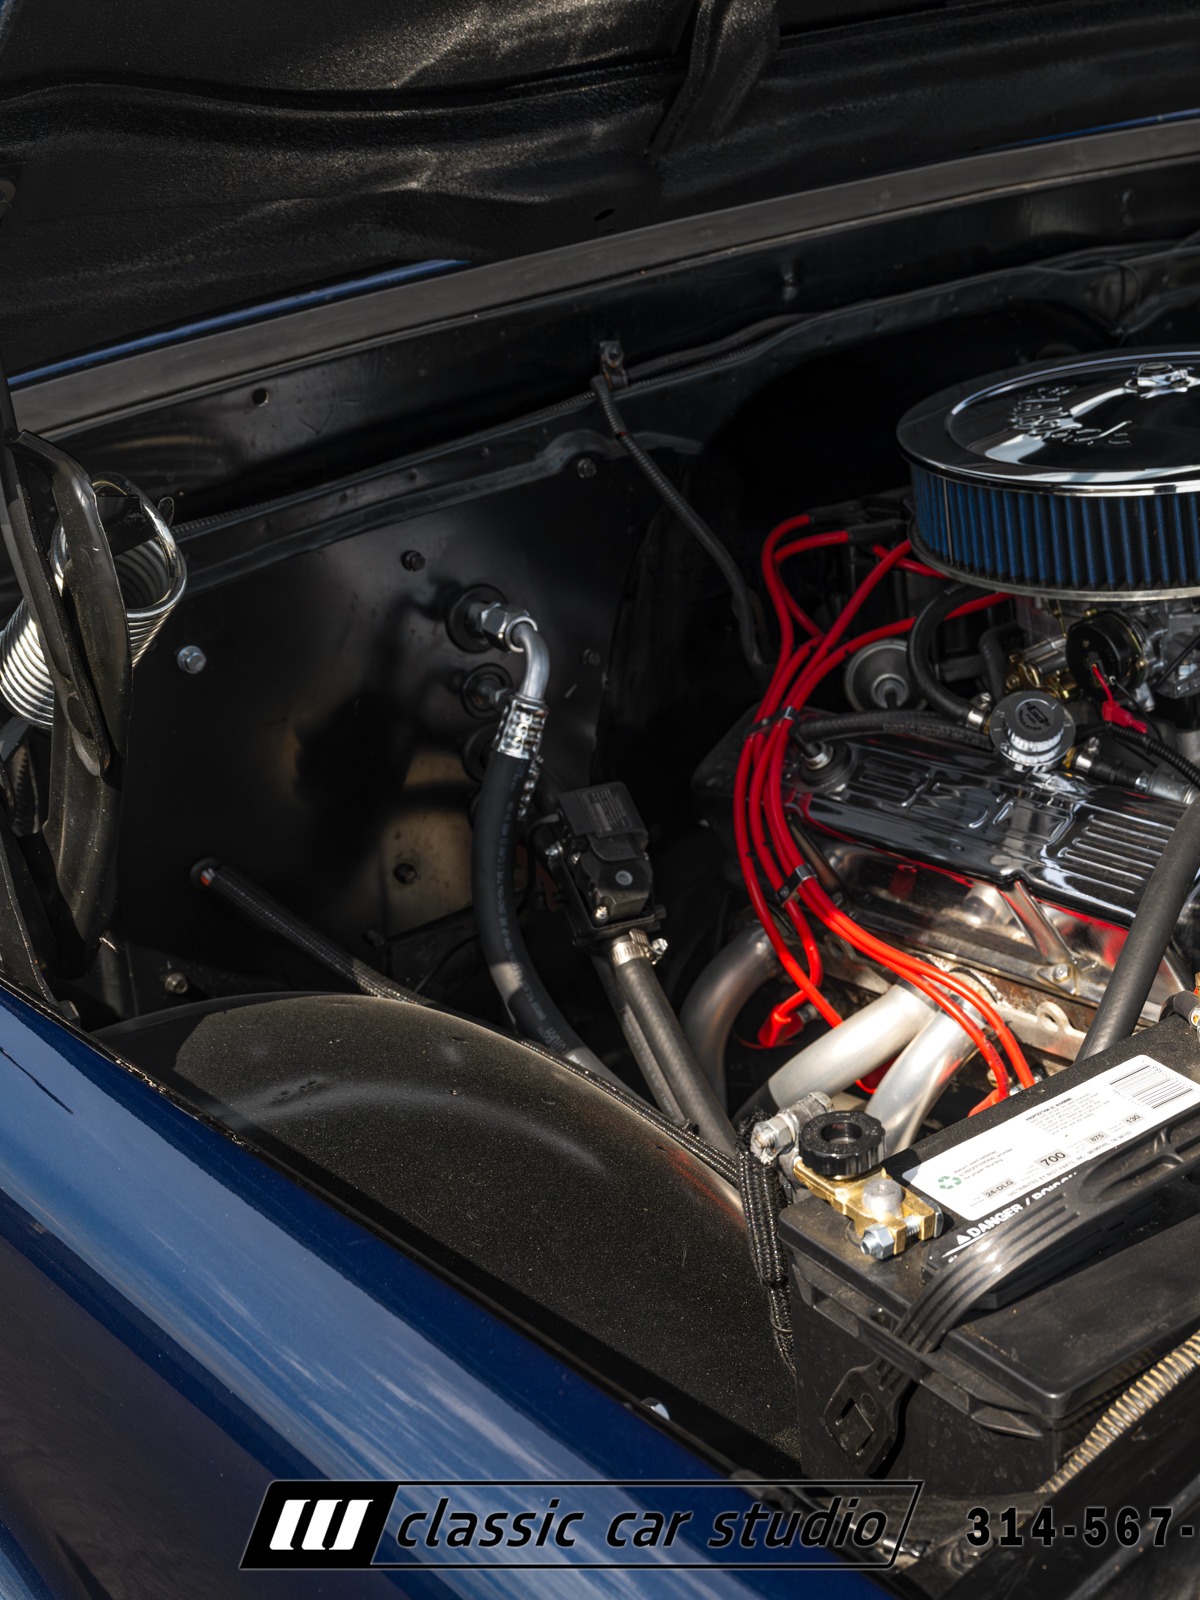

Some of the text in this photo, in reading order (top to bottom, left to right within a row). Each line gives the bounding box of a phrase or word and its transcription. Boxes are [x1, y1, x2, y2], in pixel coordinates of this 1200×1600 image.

[1126, 1114, 1141, 1124] 130
[1090, 1133, 1105, 1142] 875
[1040, 1150, 1066, 1167] 700
[985, 1180, 1014, 1197] 24-DLG
[967, 1203, 1024, 1238] DANGER
